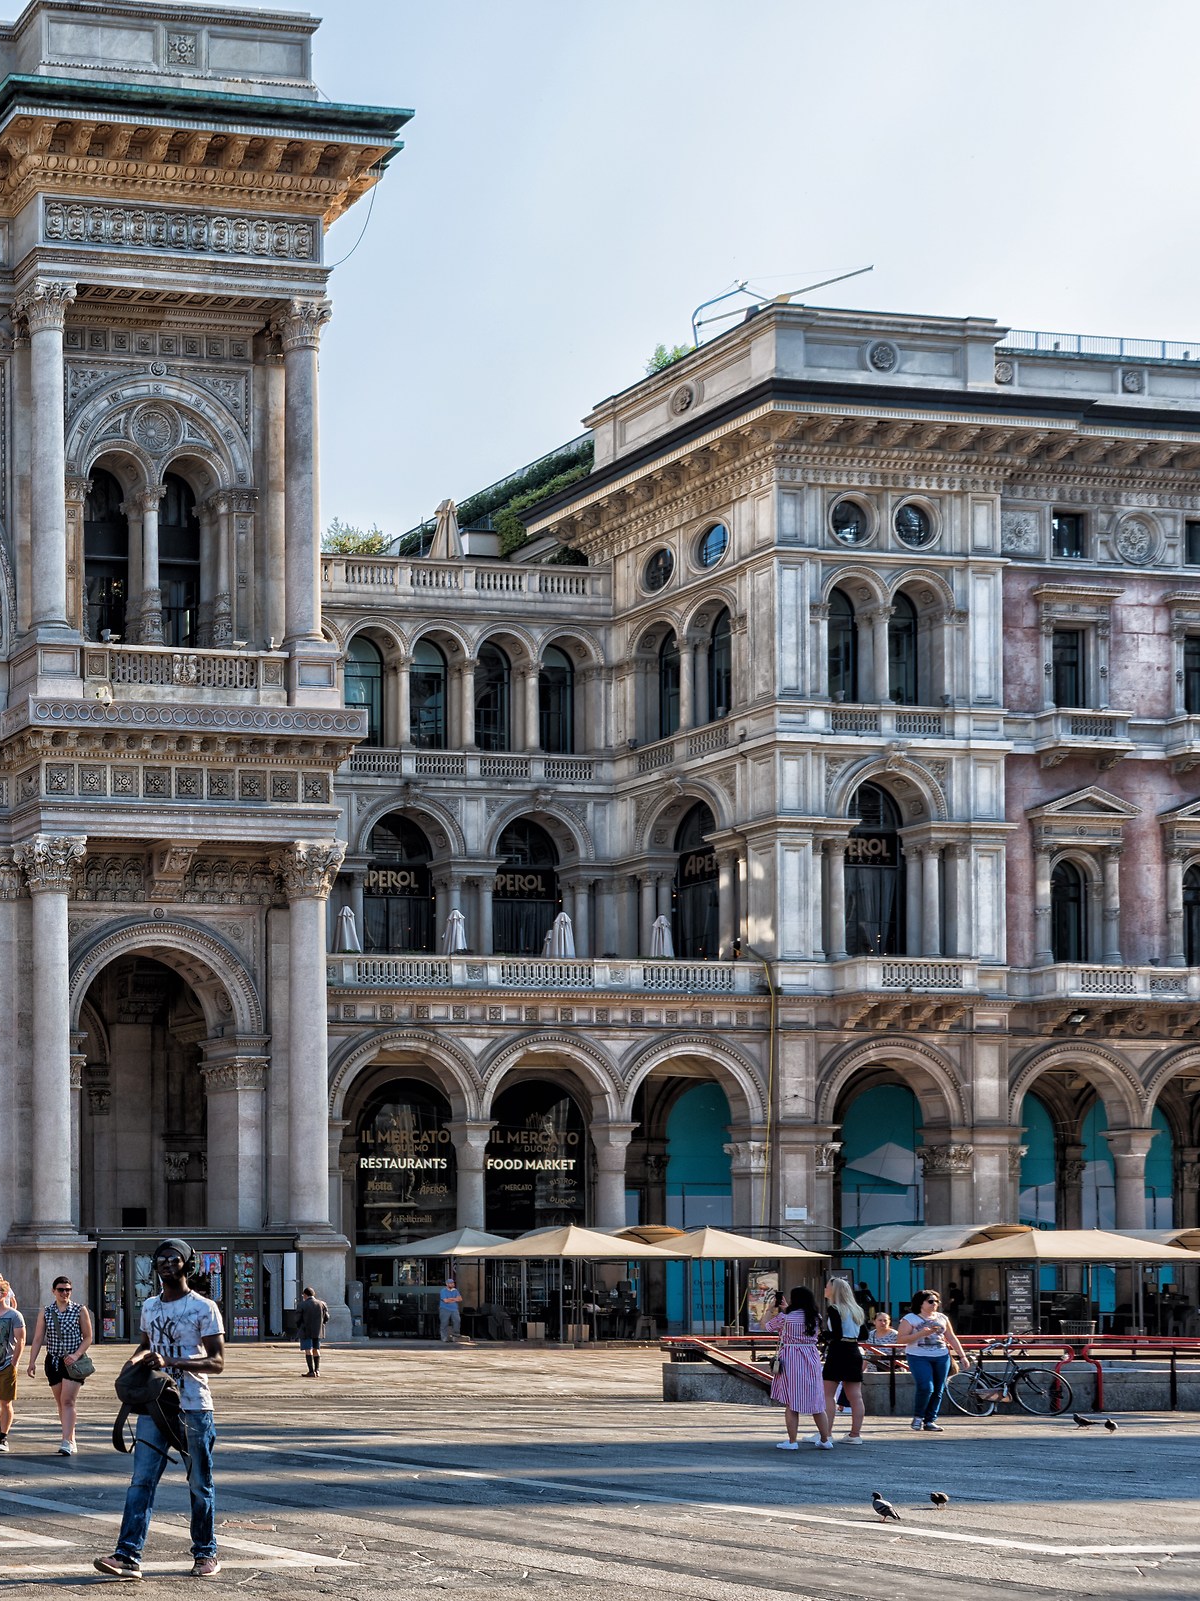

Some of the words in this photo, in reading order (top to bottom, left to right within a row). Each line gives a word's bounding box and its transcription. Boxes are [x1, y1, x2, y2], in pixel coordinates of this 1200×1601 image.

[361, 1130, 374, 1144] IL
[377, 1130, 450, 1144] MERCATO
[491, 1131, 504, 1144] IL
[507, 1131, 580, 1146] MERCATO
[524, 1145, 558, 1153] DUOMO
[360, 1157, 447, 1169] RESTAURANTS
[486, 1158, 523, 1170] FOOD
[525, 1159, 576, 1170] MARKET
[419, 1186, 448, 1195] APEROL
